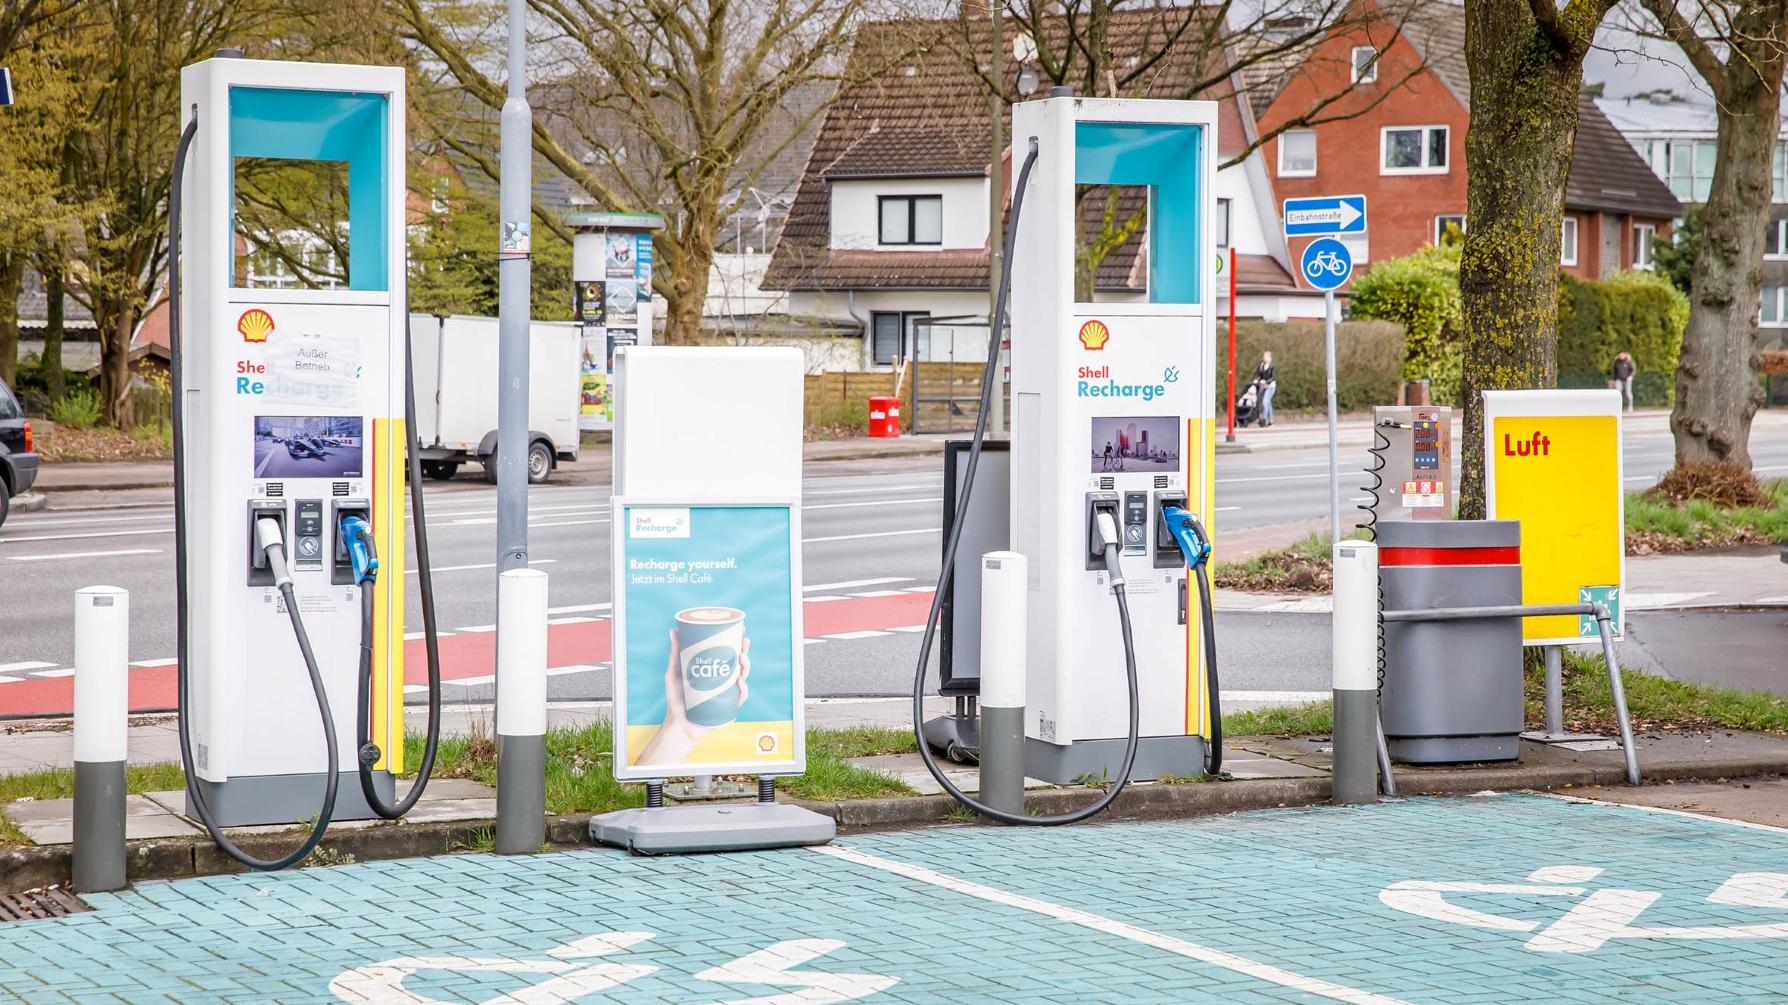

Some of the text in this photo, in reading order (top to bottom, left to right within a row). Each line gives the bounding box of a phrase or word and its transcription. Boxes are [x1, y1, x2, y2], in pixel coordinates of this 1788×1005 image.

[1289, 212, 1342, 222] Einbahnstraße
[297, 348, 329, 359] Außer
[237, 360, 269, 374] She
[295, 360, 330, 372] Betrieb
[1078, 366, 1109, 378] Shell
[1077, 379, 1165, 401] Recharge
[1504, 431, 1551, 457] Luft
[636, 523, 678, 534] Recharge
[630, 557, 738, 572] Recharge yourself.
[630, 572, 714, 585] Jetzt im Shell Café.
[695, 657, 713, 665] Shell
[691, 659, 731, 677] café
